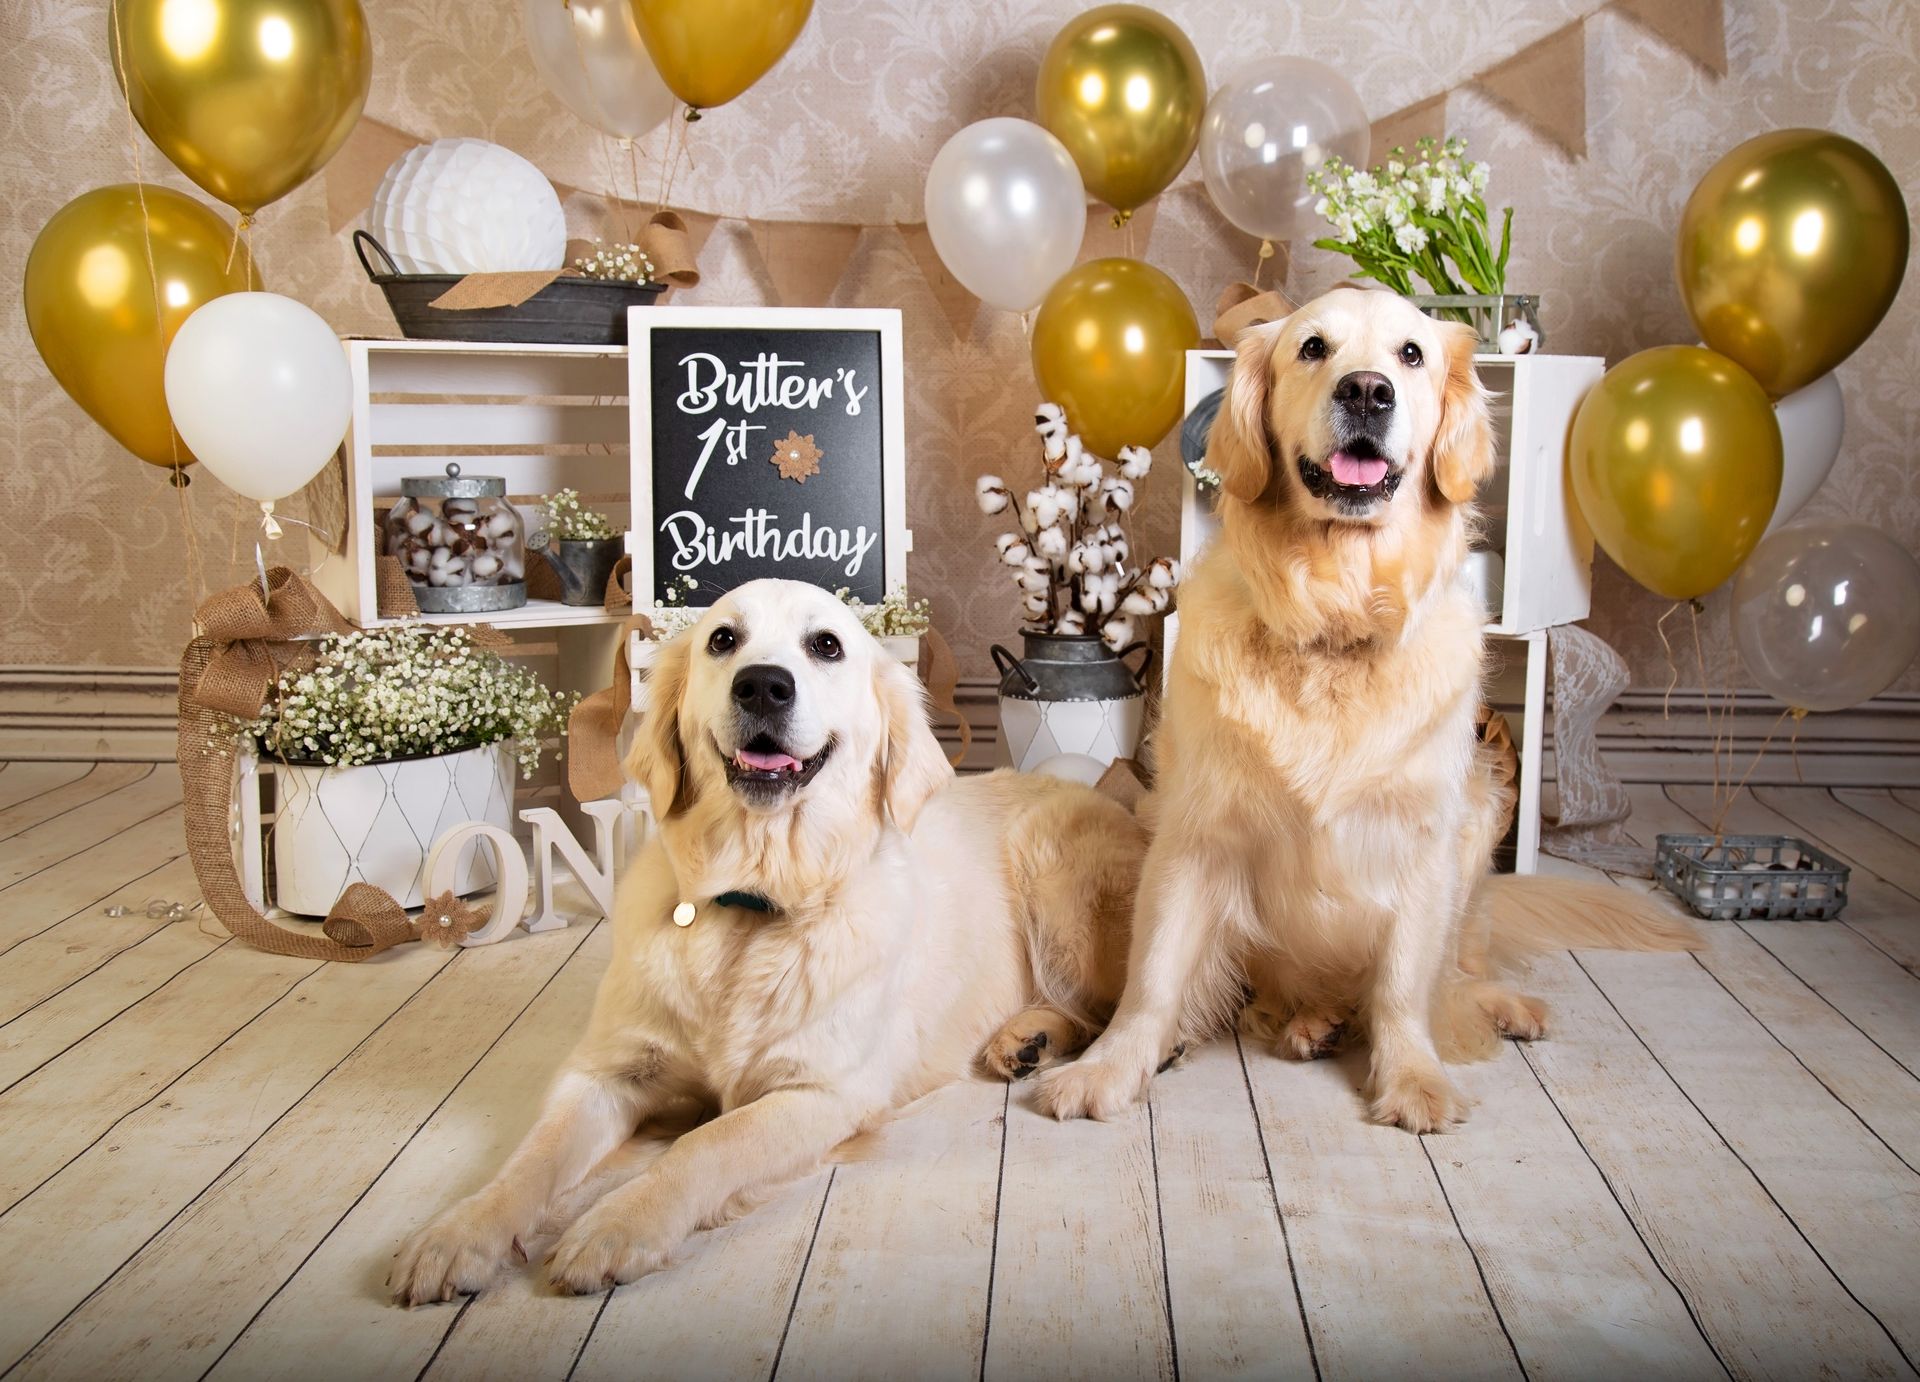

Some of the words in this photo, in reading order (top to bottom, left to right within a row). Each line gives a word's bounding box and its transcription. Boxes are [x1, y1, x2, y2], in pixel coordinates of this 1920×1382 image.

[676, 352, 869, 416] Butter's
[684, 417, 767, 501] 1st
[659, 508, 878, 578] Birthday
[422, 797, 656, 948] ON
